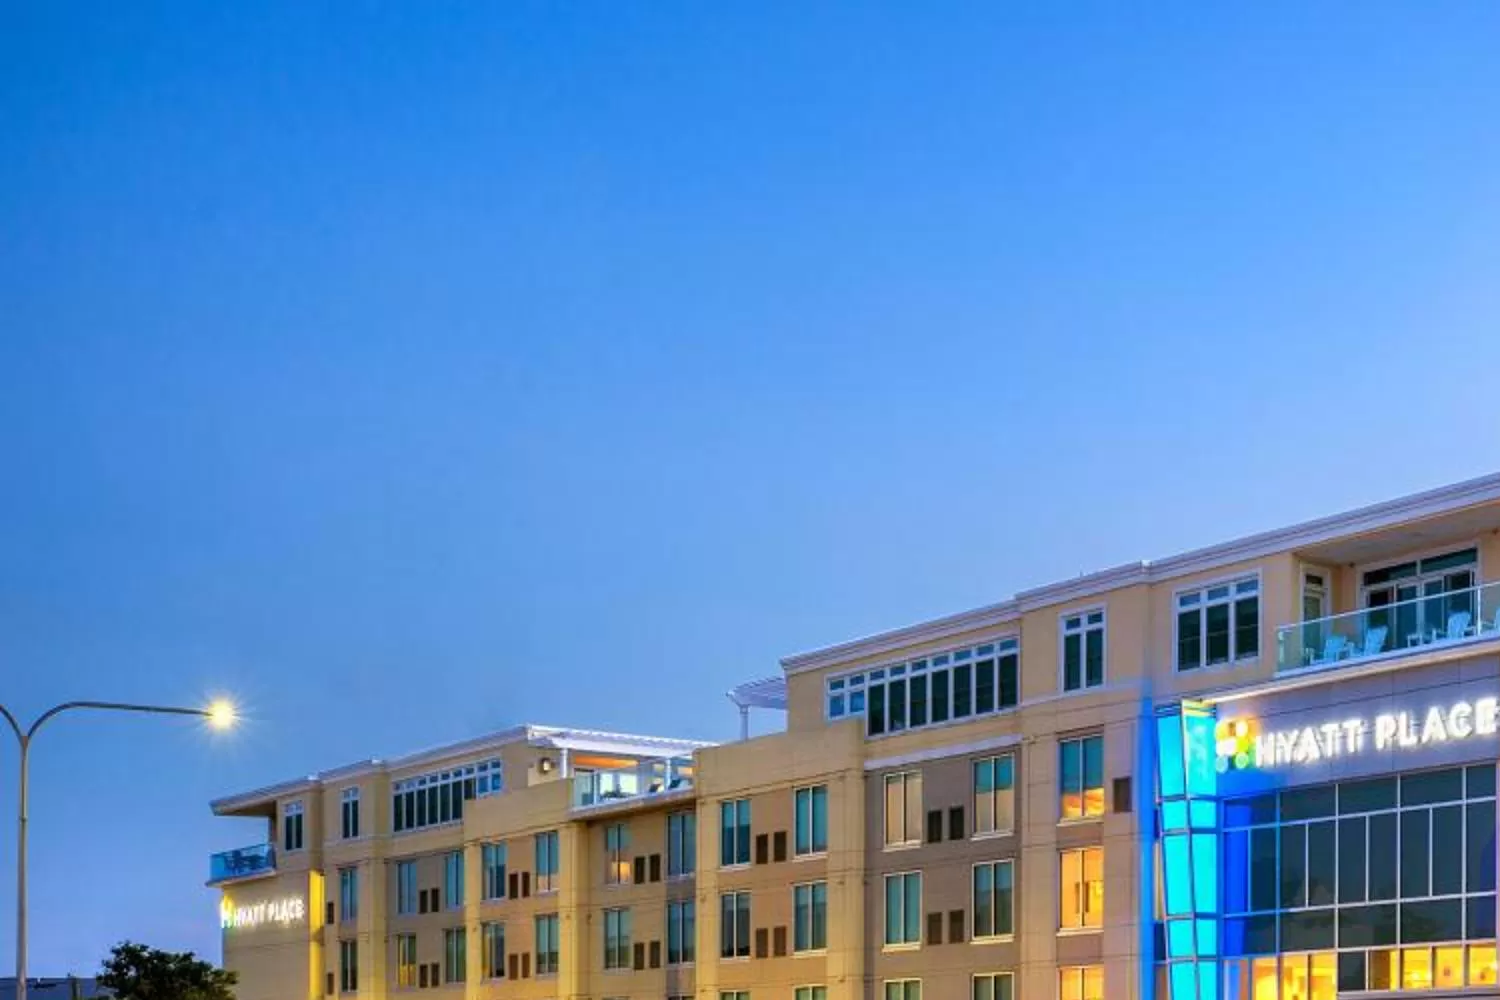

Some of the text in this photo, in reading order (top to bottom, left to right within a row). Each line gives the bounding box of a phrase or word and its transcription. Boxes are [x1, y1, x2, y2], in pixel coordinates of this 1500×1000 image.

[1255, 697, 1499, 768] HYATT PLACE
[267, 898, 304, 923] PLACE
